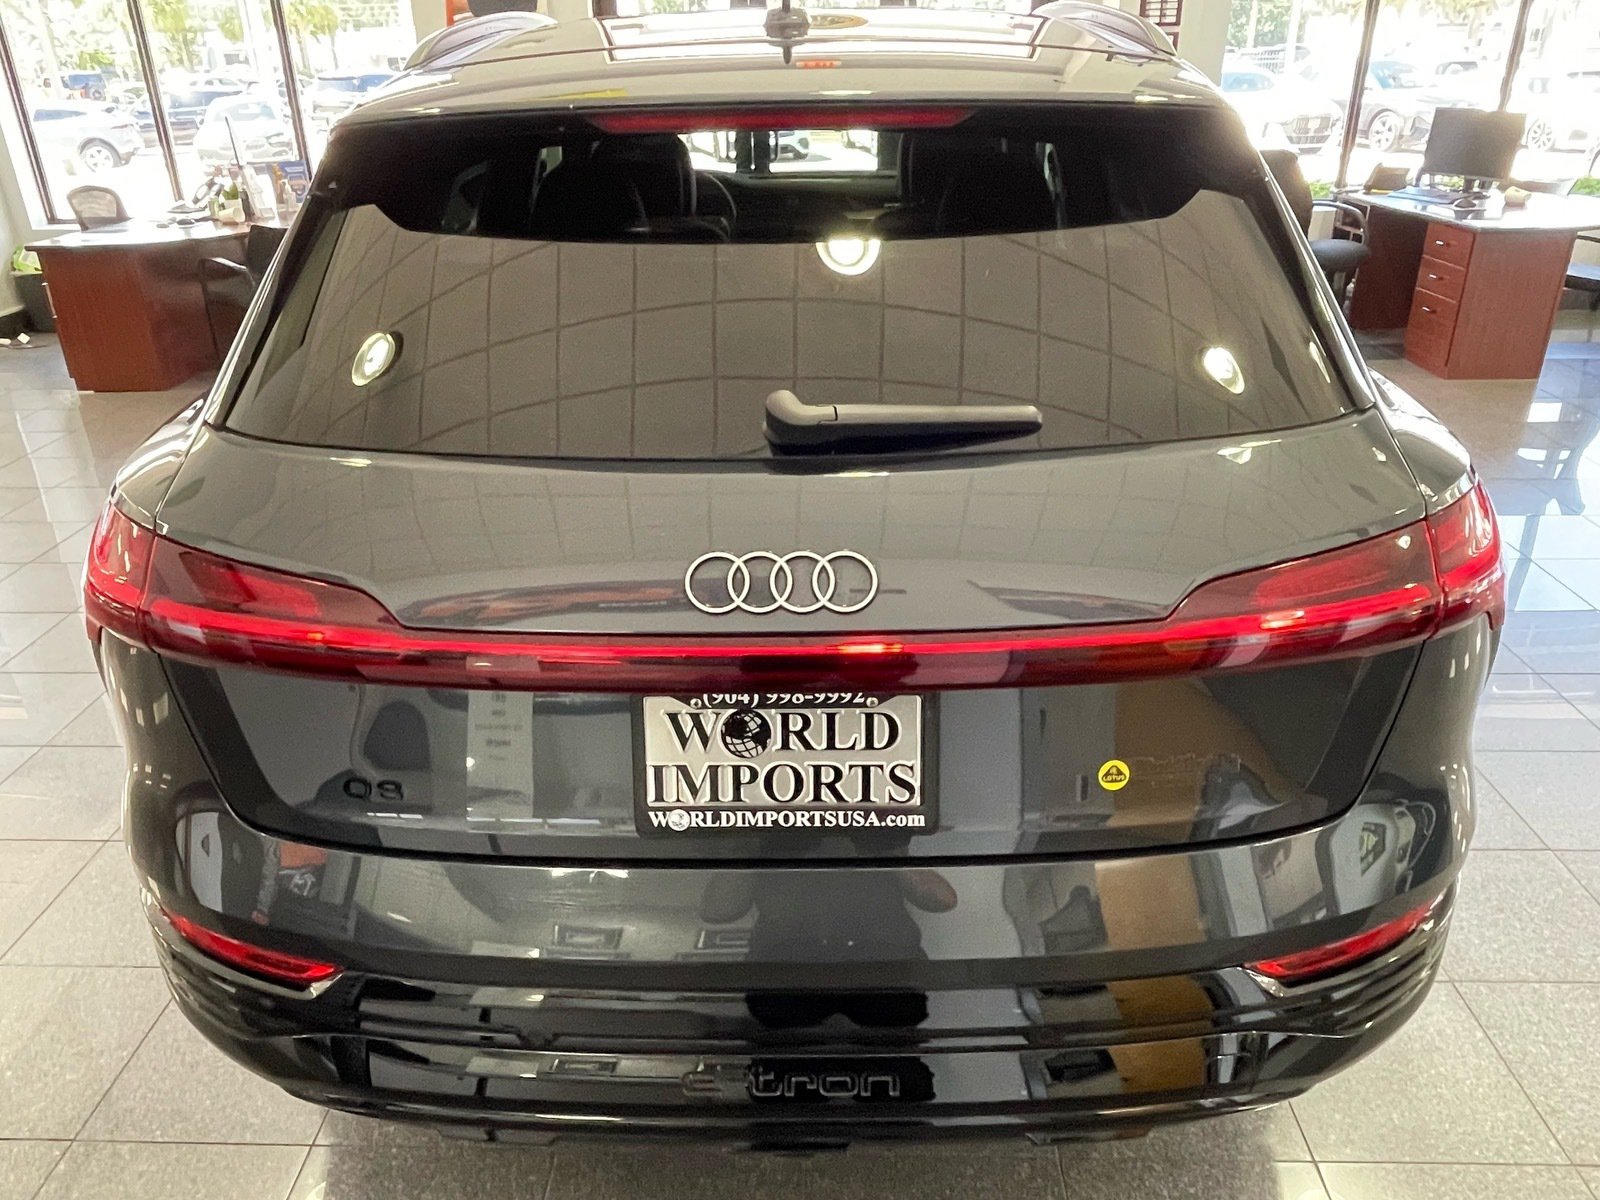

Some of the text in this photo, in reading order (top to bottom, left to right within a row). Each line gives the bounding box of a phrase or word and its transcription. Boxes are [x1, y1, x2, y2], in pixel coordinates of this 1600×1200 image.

[663, 709, 900, 758] WORLD
[650, 763, 917, 804] IMPORTS
[648, 809, 926, 832] WORLDIMPORTSUSA.com
